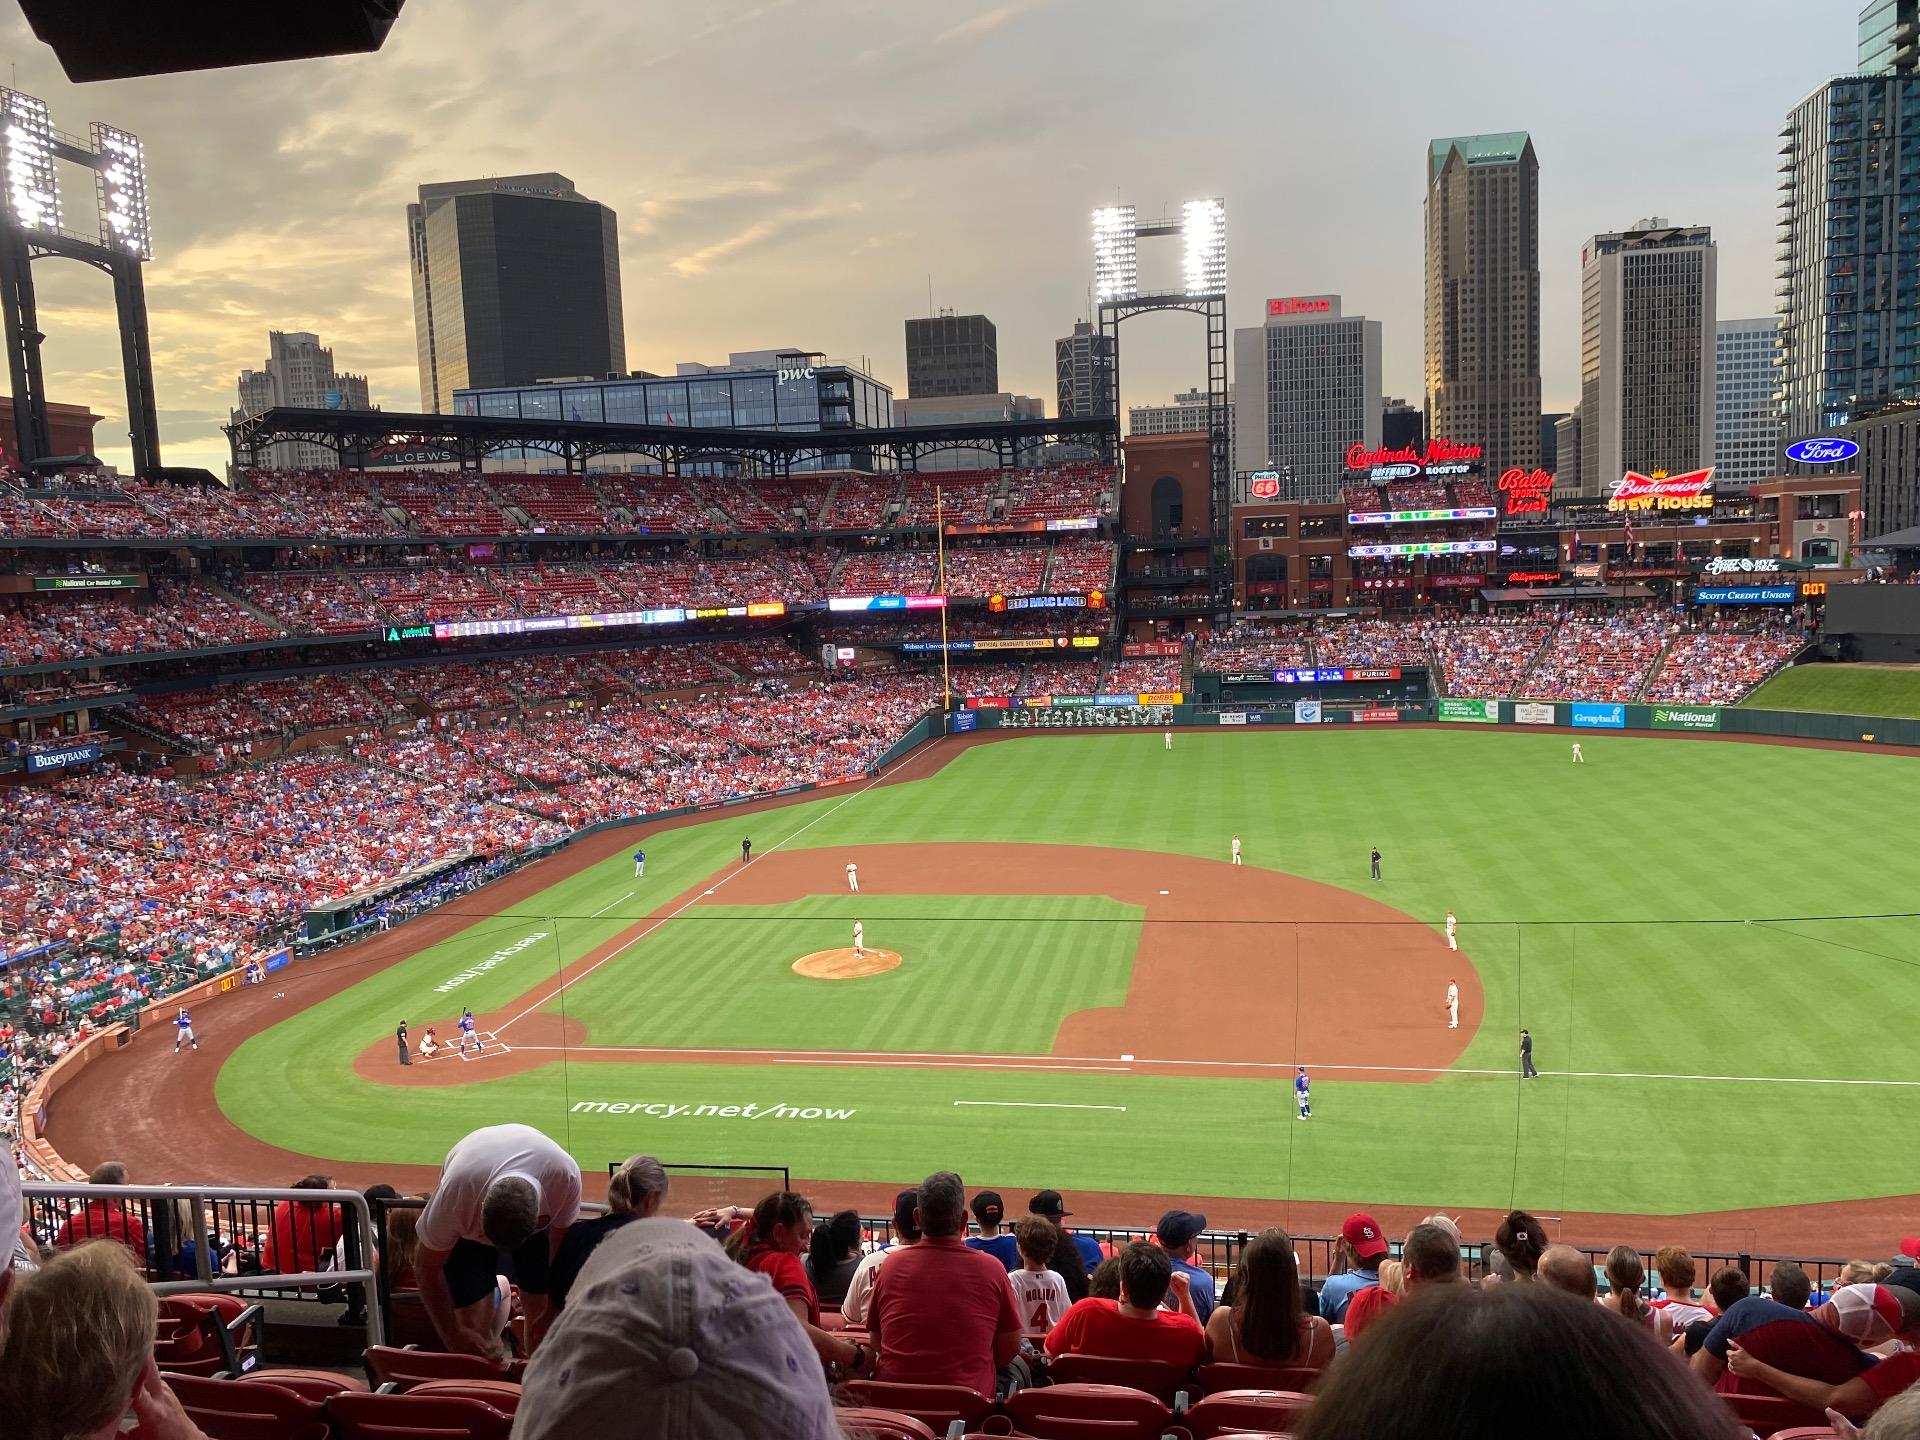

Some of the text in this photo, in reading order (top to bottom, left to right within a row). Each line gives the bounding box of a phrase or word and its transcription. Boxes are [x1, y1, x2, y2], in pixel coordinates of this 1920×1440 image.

[1270, 297, 1329, 314] Hilton
[777, 368, 815, 386] pwc
[396, 451, 451, 463] LOEWS
[1347, 439, 1481, 469] Cardinals Nation
[1801, 442, 1844, 459] Ford
[1371, 467, 1412, 477] HOFFMANN
[1426, 465, 1470, 475] ROOFTOP
[1255, 482, 1276, 493] 66
[1498, 468, 1555, 491] Bally
[1609, 479, 1712, 497] Budweiser
[1510, 489, 1541, 498] SPORTS
[1608, 495, 1713, 512] BREW HOUSE
[1802, 583, 1825, 595] 0:07
[1105, 696, 1134, 704] Ballpark
[1668, 712, 1717, 723] National
[433, 932, 550, 993] mercy.net/now
[569, 1101, 857, 1120] mercy.net/now
[1030, 1302, 1049, 1332] 4
